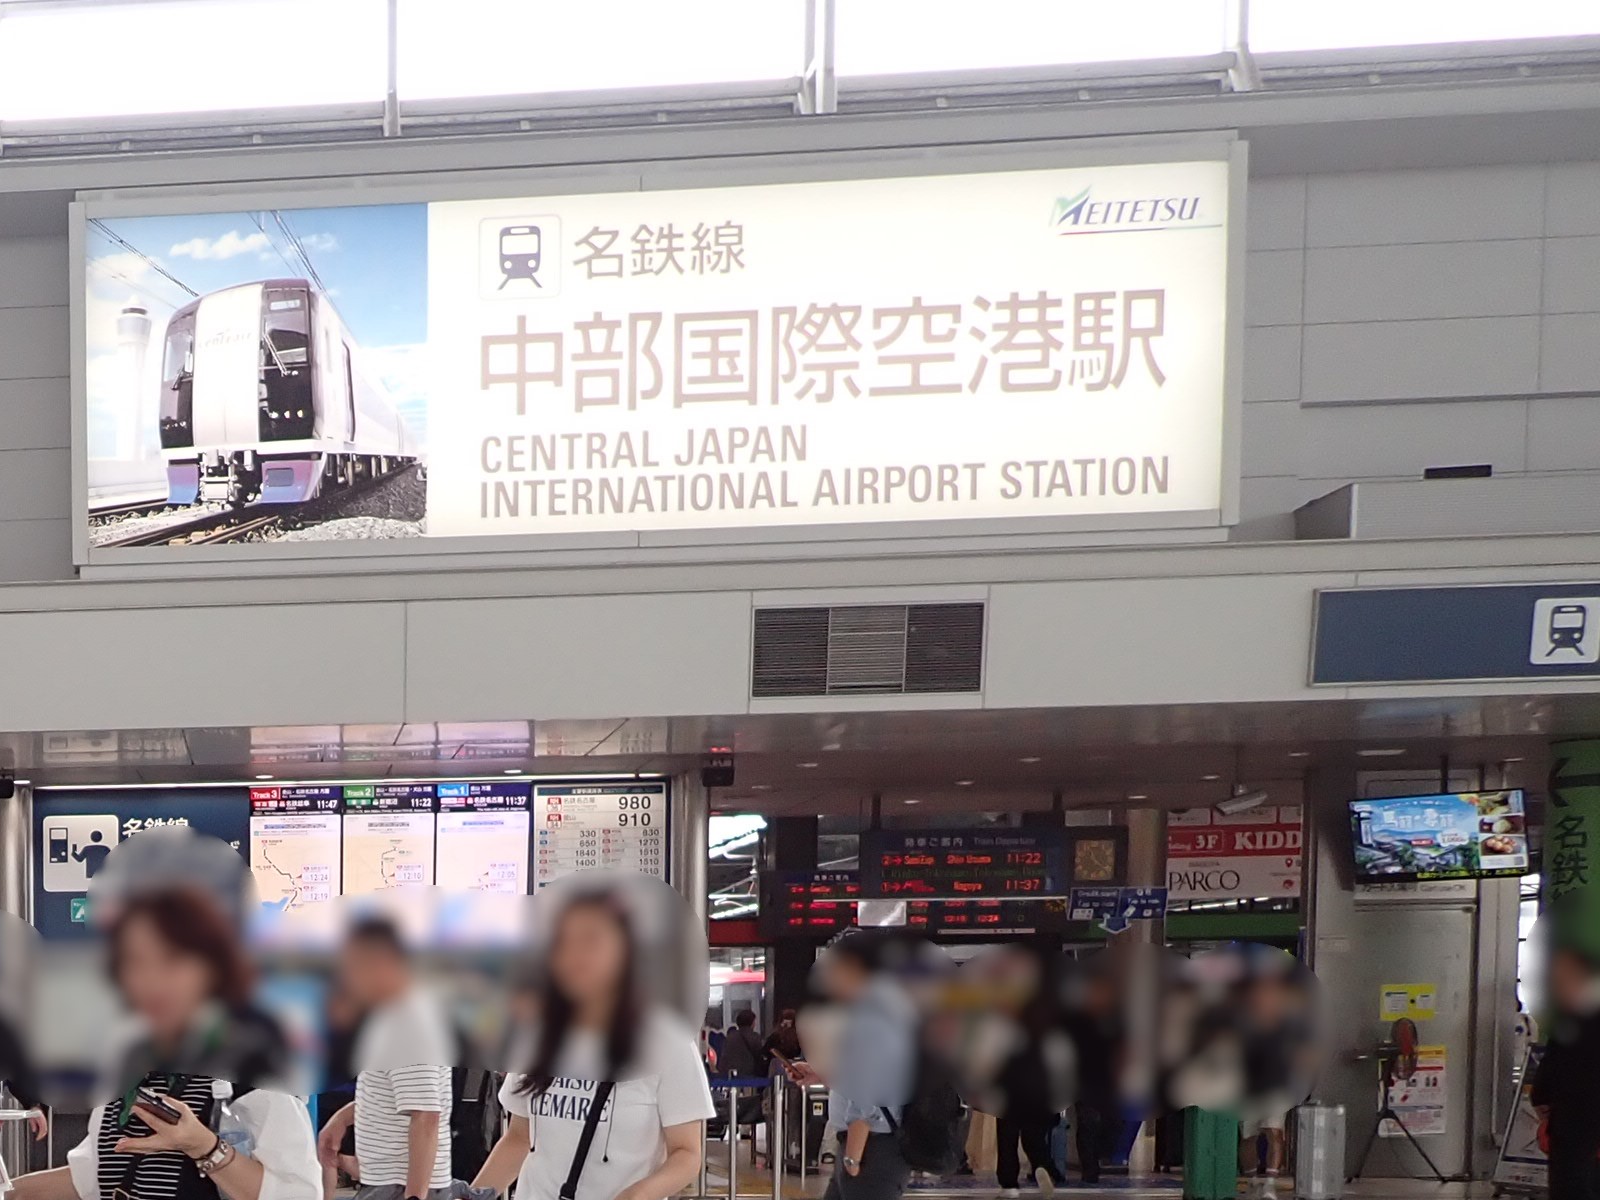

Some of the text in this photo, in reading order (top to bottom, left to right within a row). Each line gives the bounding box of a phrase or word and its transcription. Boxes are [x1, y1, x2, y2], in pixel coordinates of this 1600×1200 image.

[1051, 185, 1201, 228] MEITETSU
[572, 220, 747, 282] 名鉄線
[479, 287, 1167, 417] 中部国際空港駅
[480, 425, 808, 474] CENTRAL JAPAN
[480, 455, 1170, 519] INTERNATIONAL AIRPORT STATION
[317, 799, 338, 809] 11:47
[410, 798, 431, 807] 11:22
[505, 796, 527, 806] 11:37
[618, 796, 651, 810] 980
[618, 813, 651, 826] 910
[1195, 835, 1219, 849] 3F
[1007, 853, 1041, 863] 11:22
[1552, 815, 1589, 898] 名鉄
[1006, 879, 1040, 890] 11:37
[1168, 869, 1240, 892] PARCO
